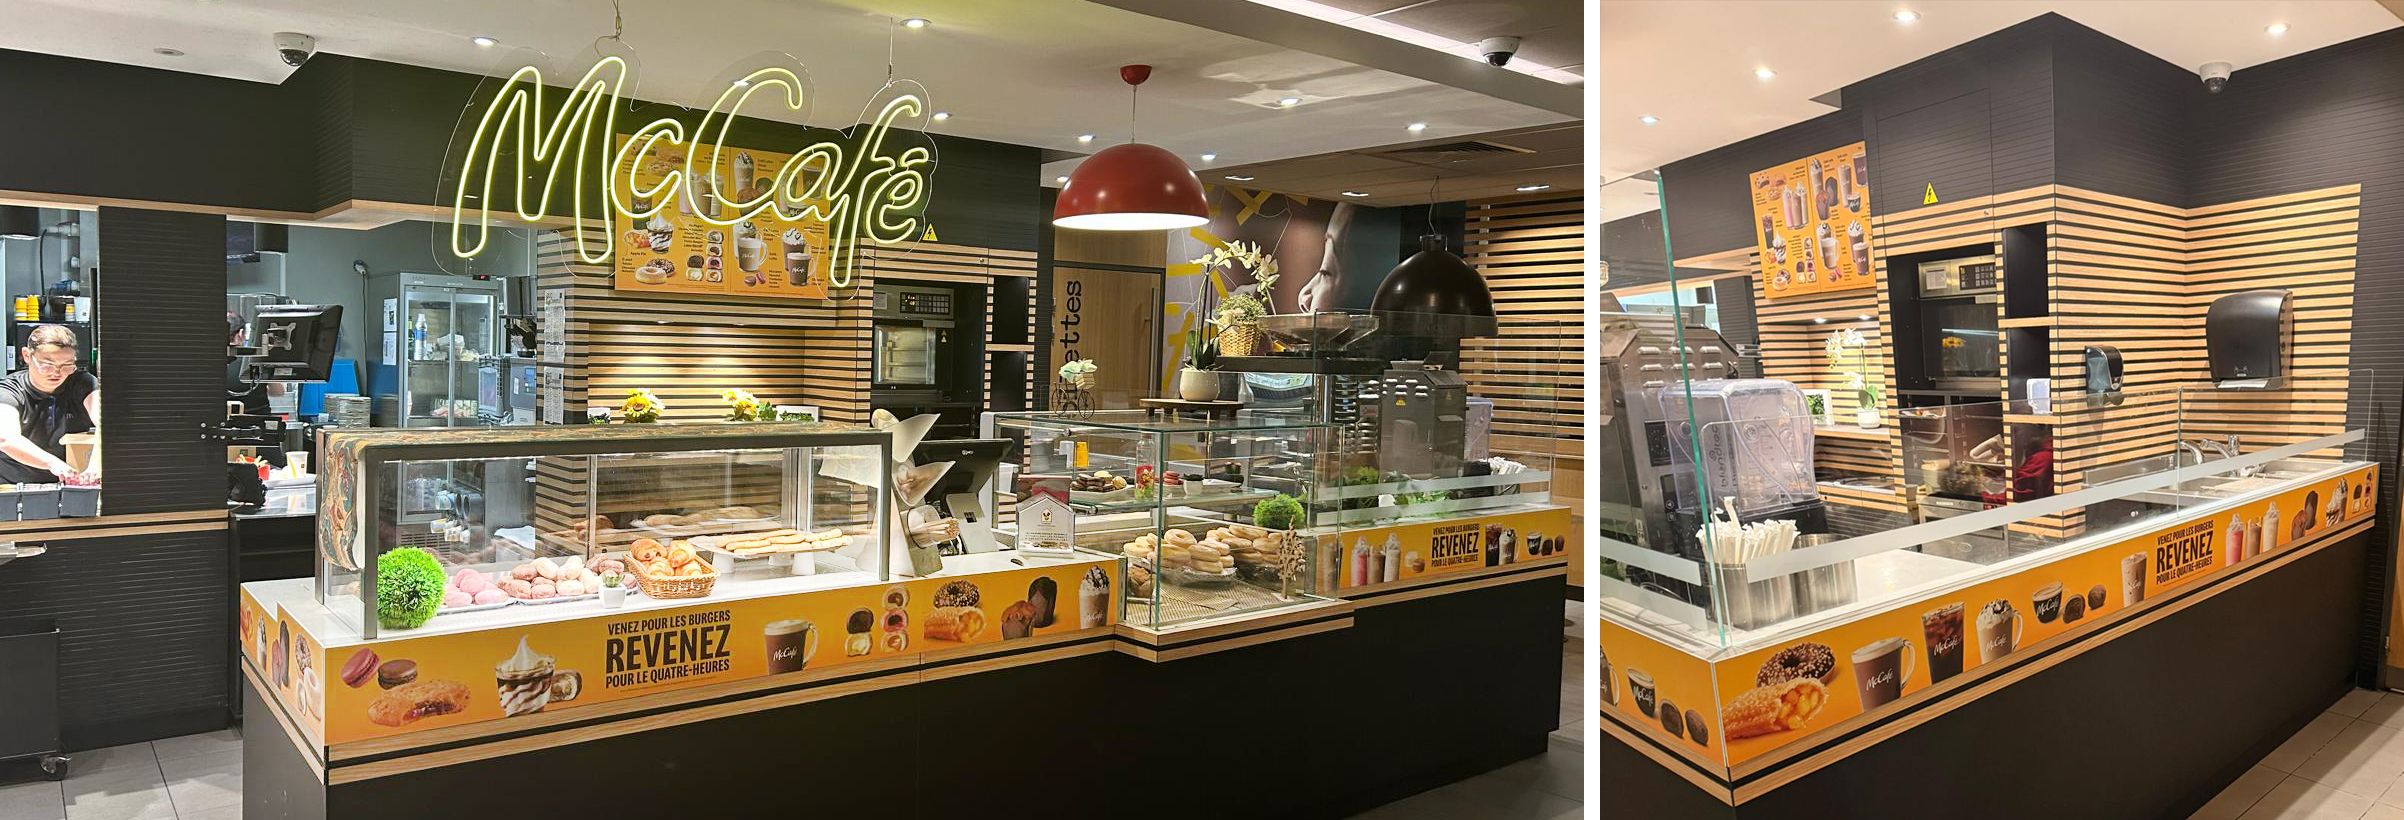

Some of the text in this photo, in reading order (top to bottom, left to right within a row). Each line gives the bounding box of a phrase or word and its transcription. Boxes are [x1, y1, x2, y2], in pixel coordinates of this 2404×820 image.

[454, 55, 929, 288] McCafé
[1432, 531, 1480, 559] REVENEZ
[2157, 533, 2173, 546] VENEZ
[2186, 526, 2194, 537] LES
[2156, 530, 2214, 574] REVENEZ
[608, 609, 731, 636] VENEZ POUR LES BURGERS
[605, 624, 731, 674] REVENEZ
[605, 673, 635, 689] POUR
[636, 670, 648, 684] LE
[650, 659, 730, 684] QUATRE-HEURES
